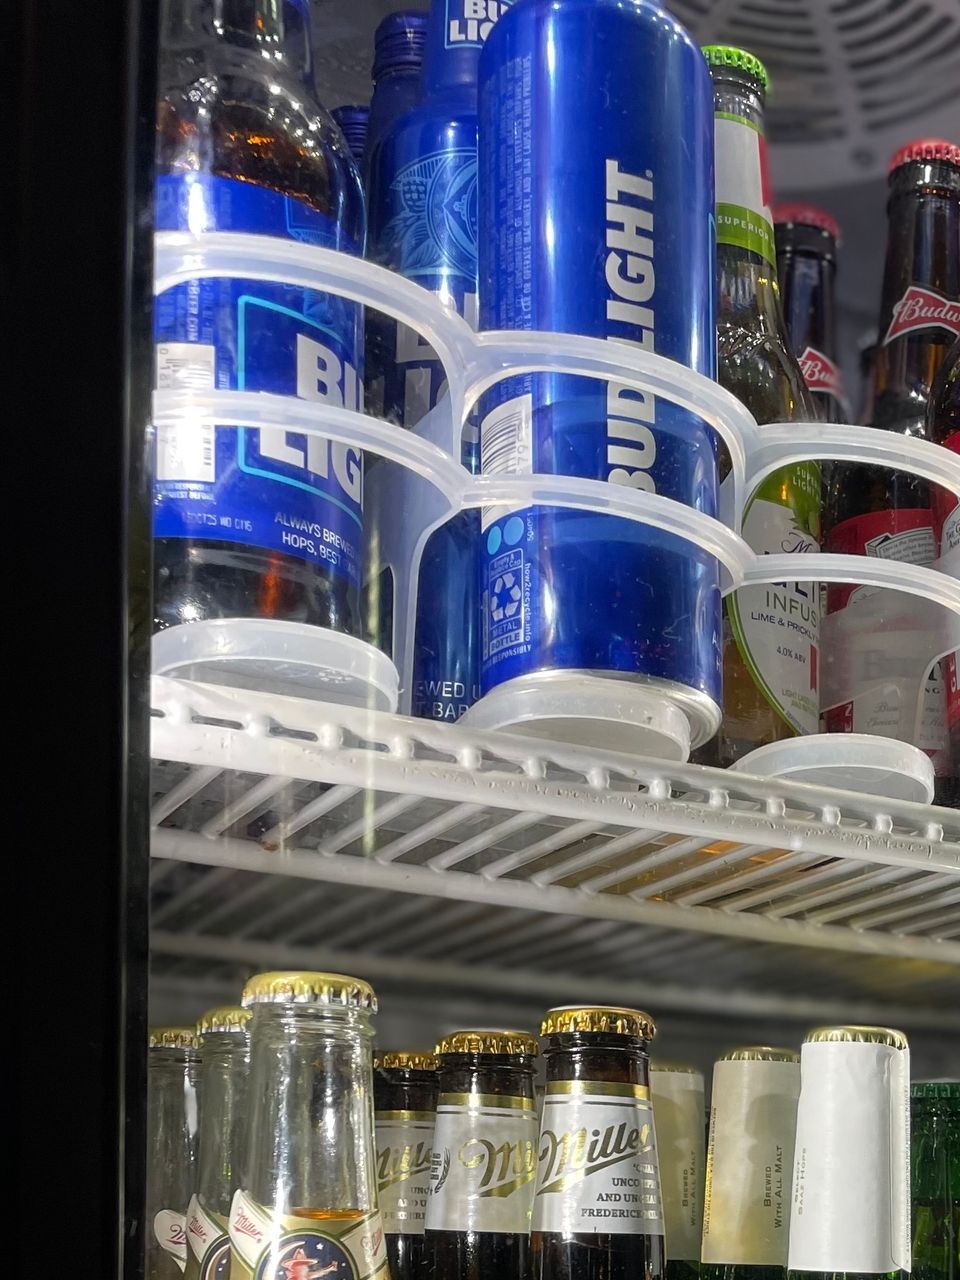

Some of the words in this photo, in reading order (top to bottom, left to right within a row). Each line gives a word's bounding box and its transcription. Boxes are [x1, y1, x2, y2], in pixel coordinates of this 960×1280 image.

[717, 214, 769, 241] SUPERIOR
[274, 511, 321, 538] ALWAYS
[282, 532, 318, 556] HOPS,
[751, 611, 776, 623] LIME
[776, 645, 794, 659] 4.0%
[774, 1145, 783, 1174] MALT
[596, 1192, 622, 1203] AND
[763, 1166, 772, 1208] BREWED
[233, 1206, 264, 1243] Miller
